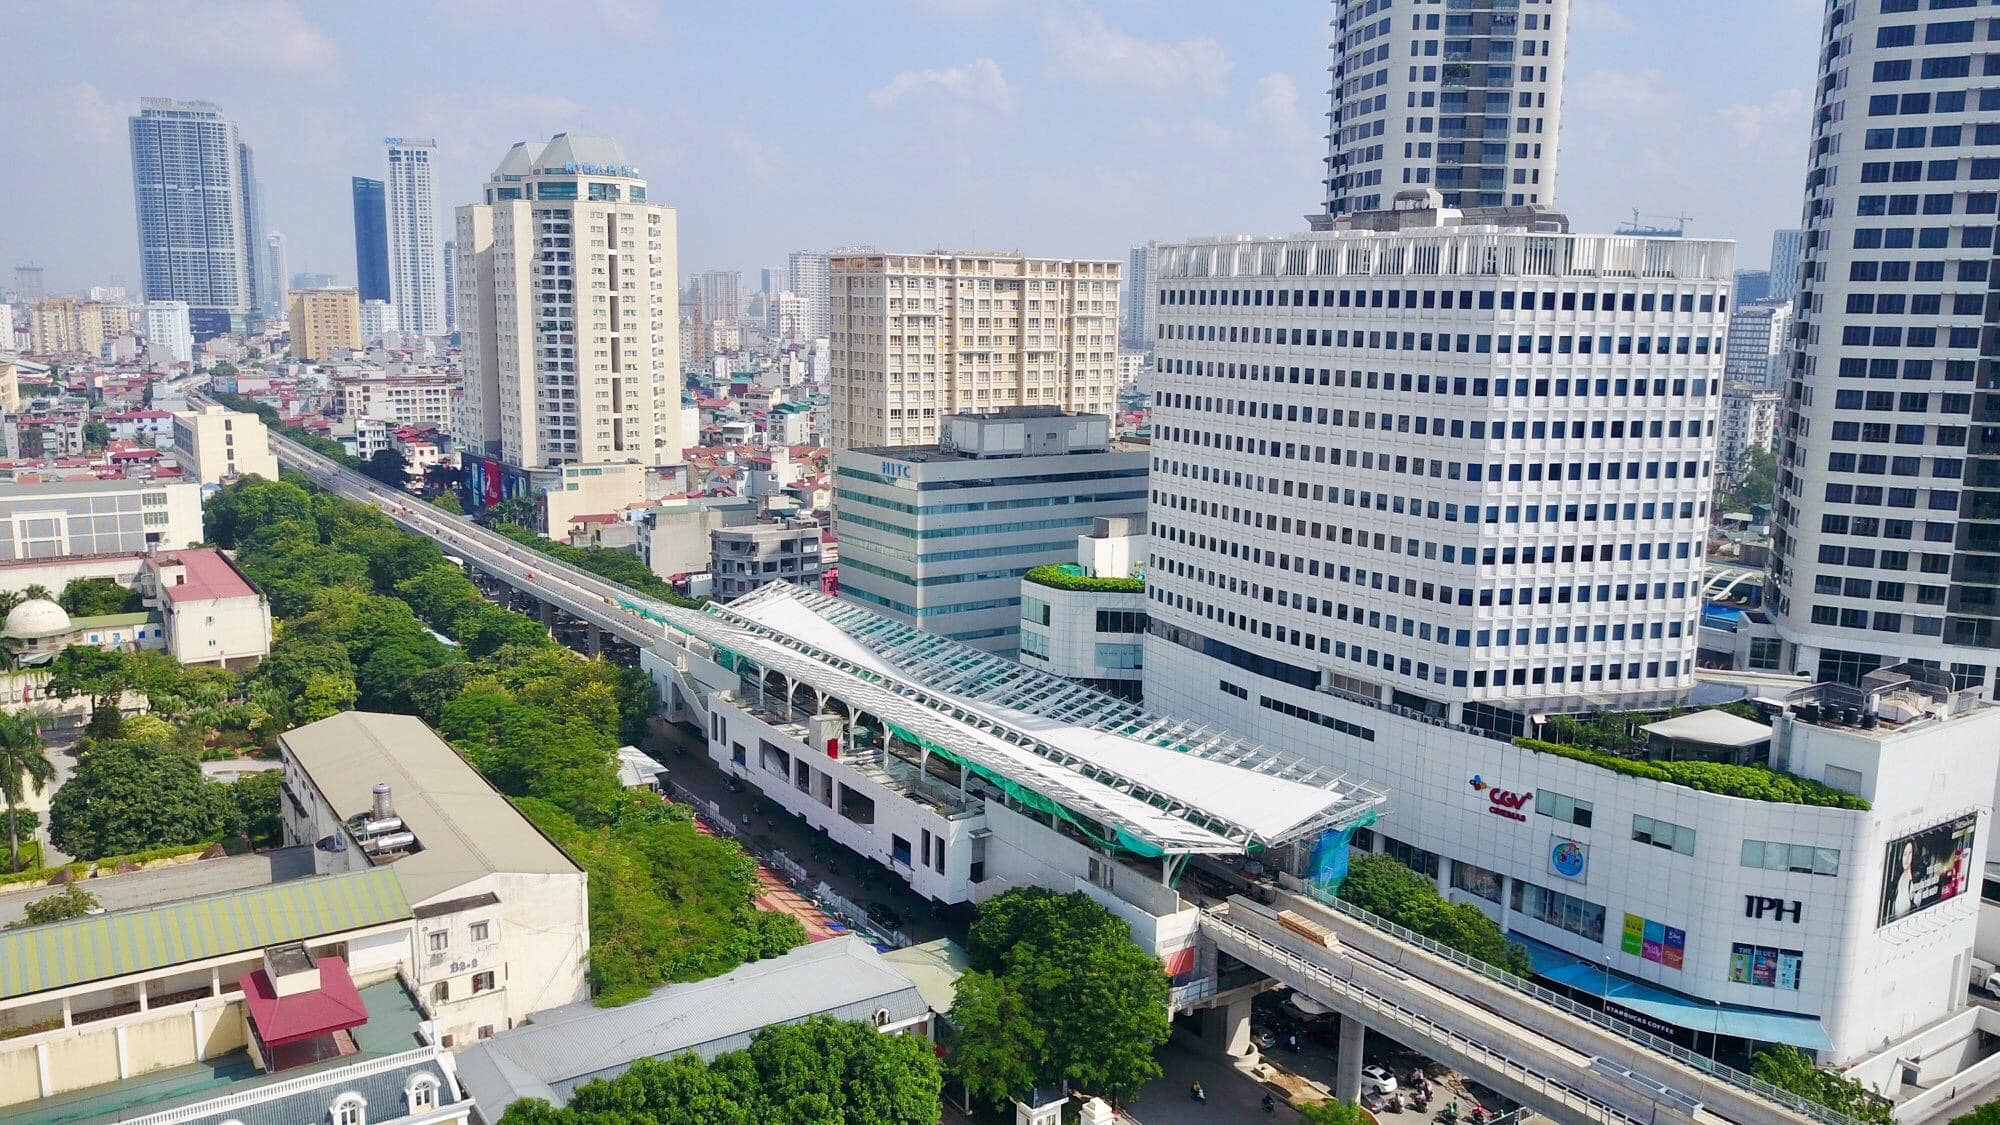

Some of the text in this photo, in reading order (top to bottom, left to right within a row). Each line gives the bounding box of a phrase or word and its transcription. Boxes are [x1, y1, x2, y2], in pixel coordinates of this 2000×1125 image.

[882, 461, 911, 478] HITC
[1489, 788, 1533, 810] CGV
[1745, 894, 1802, 924] IPH
[1606, 1005, 1675, 1035] STARBUCKS COFFEE
